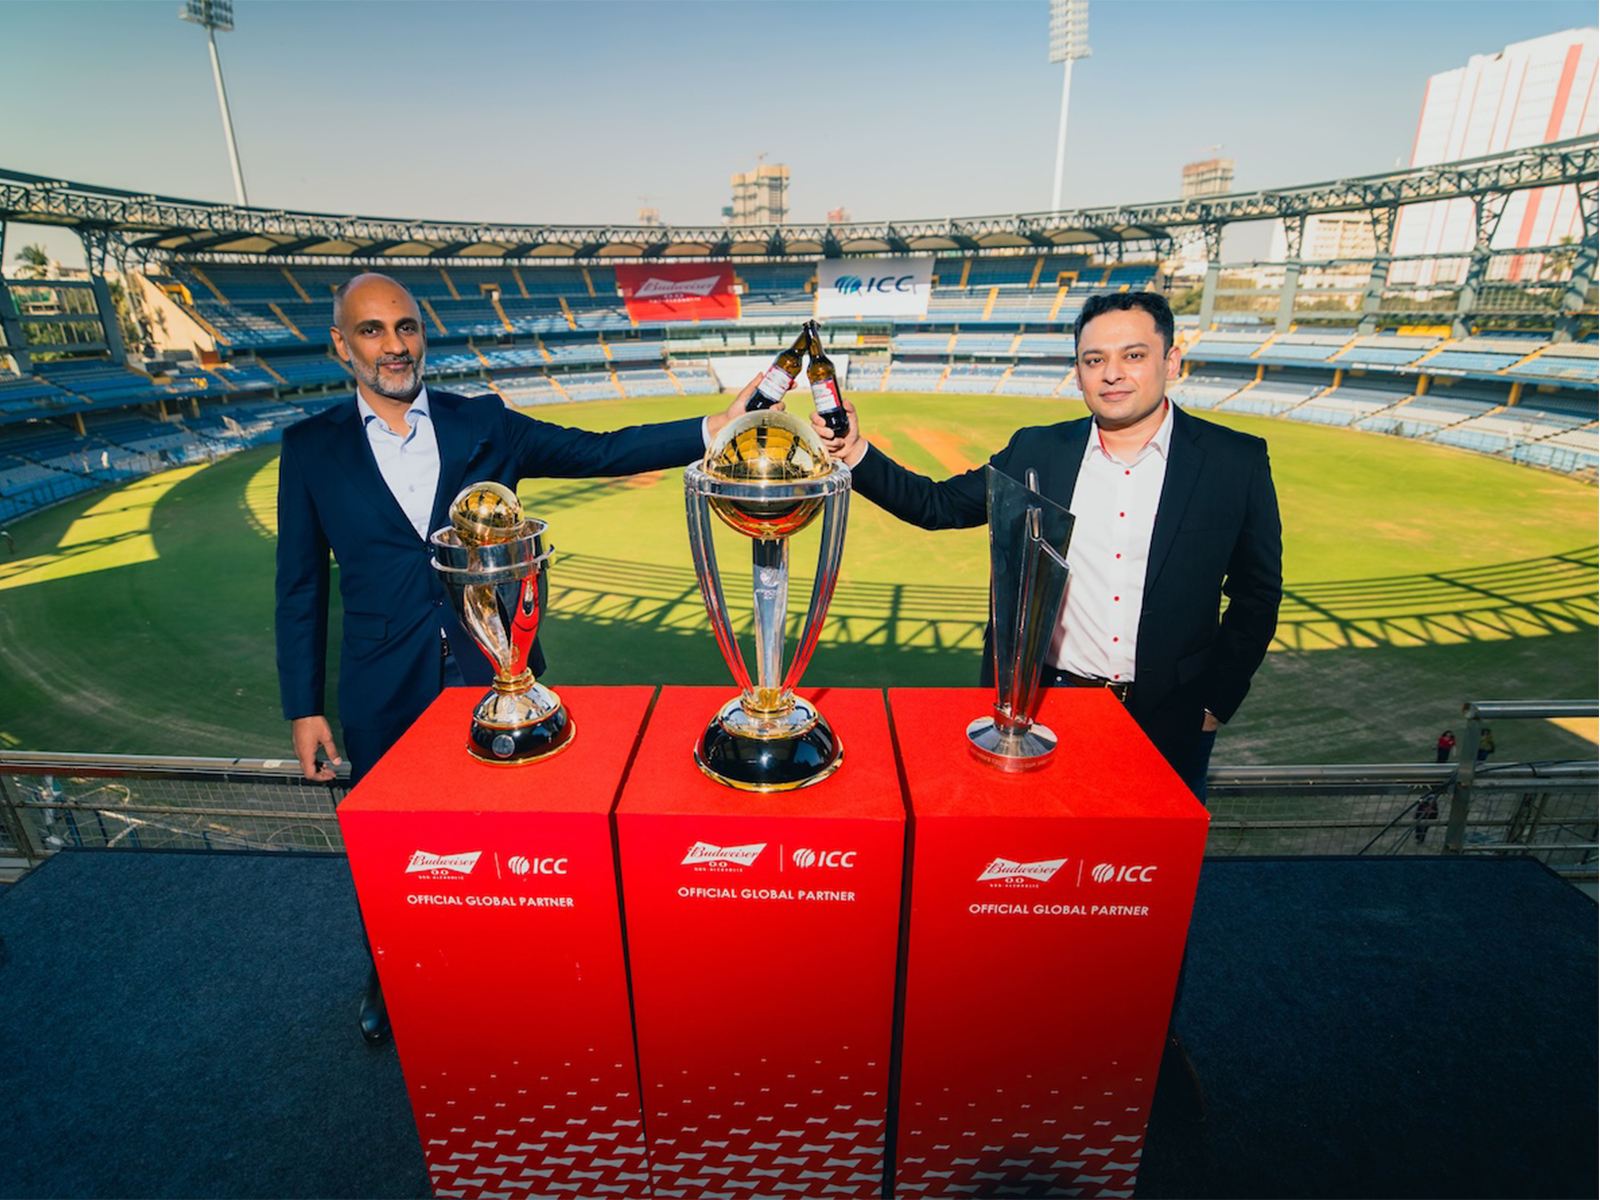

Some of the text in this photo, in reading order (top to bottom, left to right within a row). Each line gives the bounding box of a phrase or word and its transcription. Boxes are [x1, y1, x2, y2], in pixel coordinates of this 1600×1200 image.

[867, 275, 914, 293] ICC
[687, 846, 758, 858] Budweiser
[408, 854, 476, 866] Budweiser
[533, 858, 568, 874] ICC
[818, 851, 857, 868] ICC
[985, 862, 1058, 874] Budweiser
[1116, 866, 1158, 882] ICC
[407, 894, 574, 907] OFFICIAL GLOBAL PARTNER
[677, 887, 855, 902] OFFICIAL GLOBAL PARTNER
[969, 904, 1149, 916] OFFICIAL GLOBAL PARTNER
